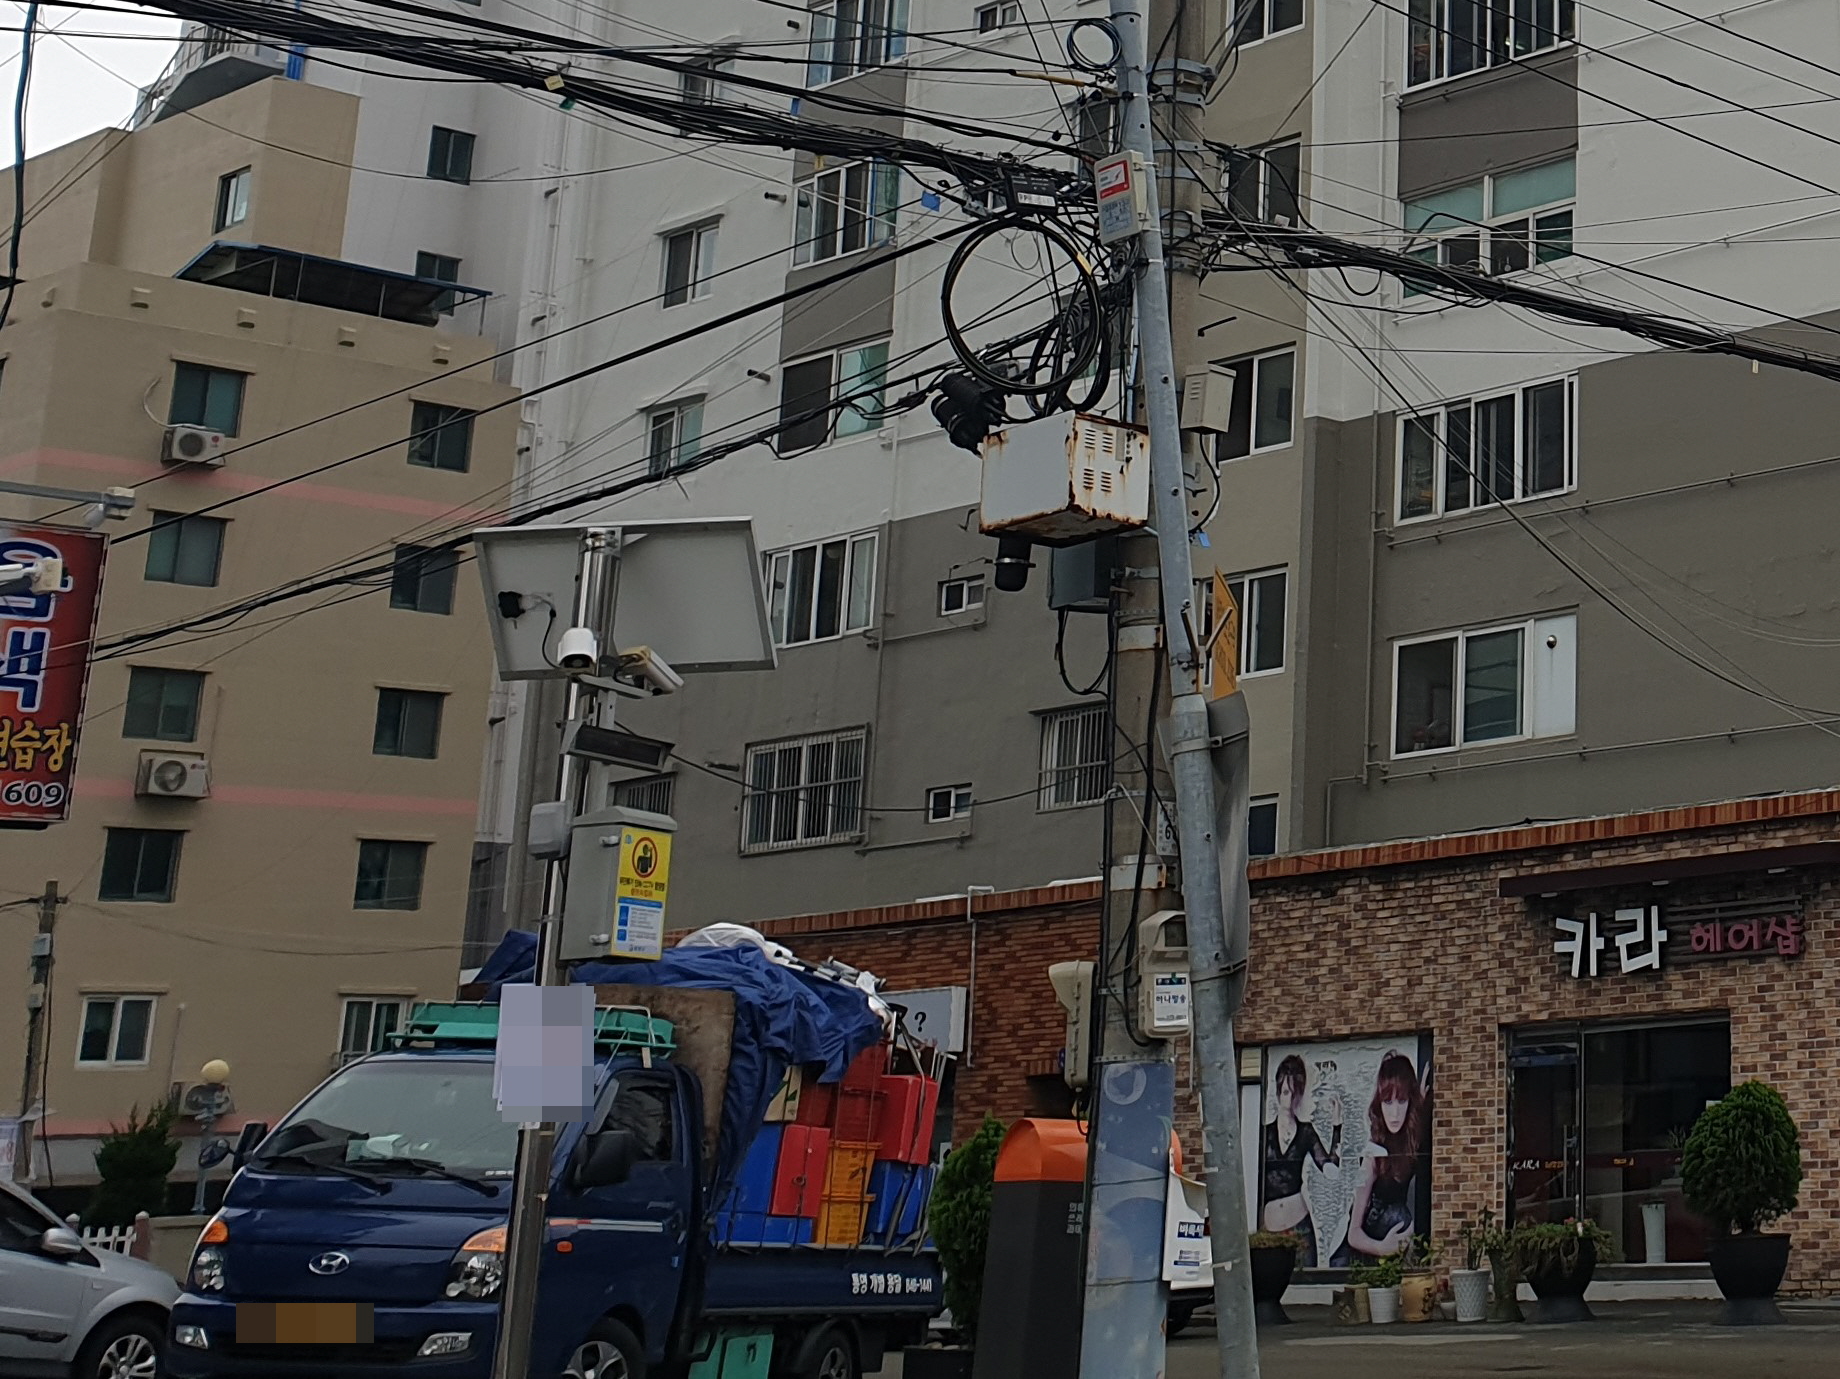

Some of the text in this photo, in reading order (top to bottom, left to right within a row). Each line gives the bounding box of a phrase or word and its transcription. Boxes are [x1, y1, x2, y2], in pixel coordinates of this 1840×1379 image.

[0, 781, 65, 807] 609
[1553, 905, 1804, 978] 카라 헤어샵
